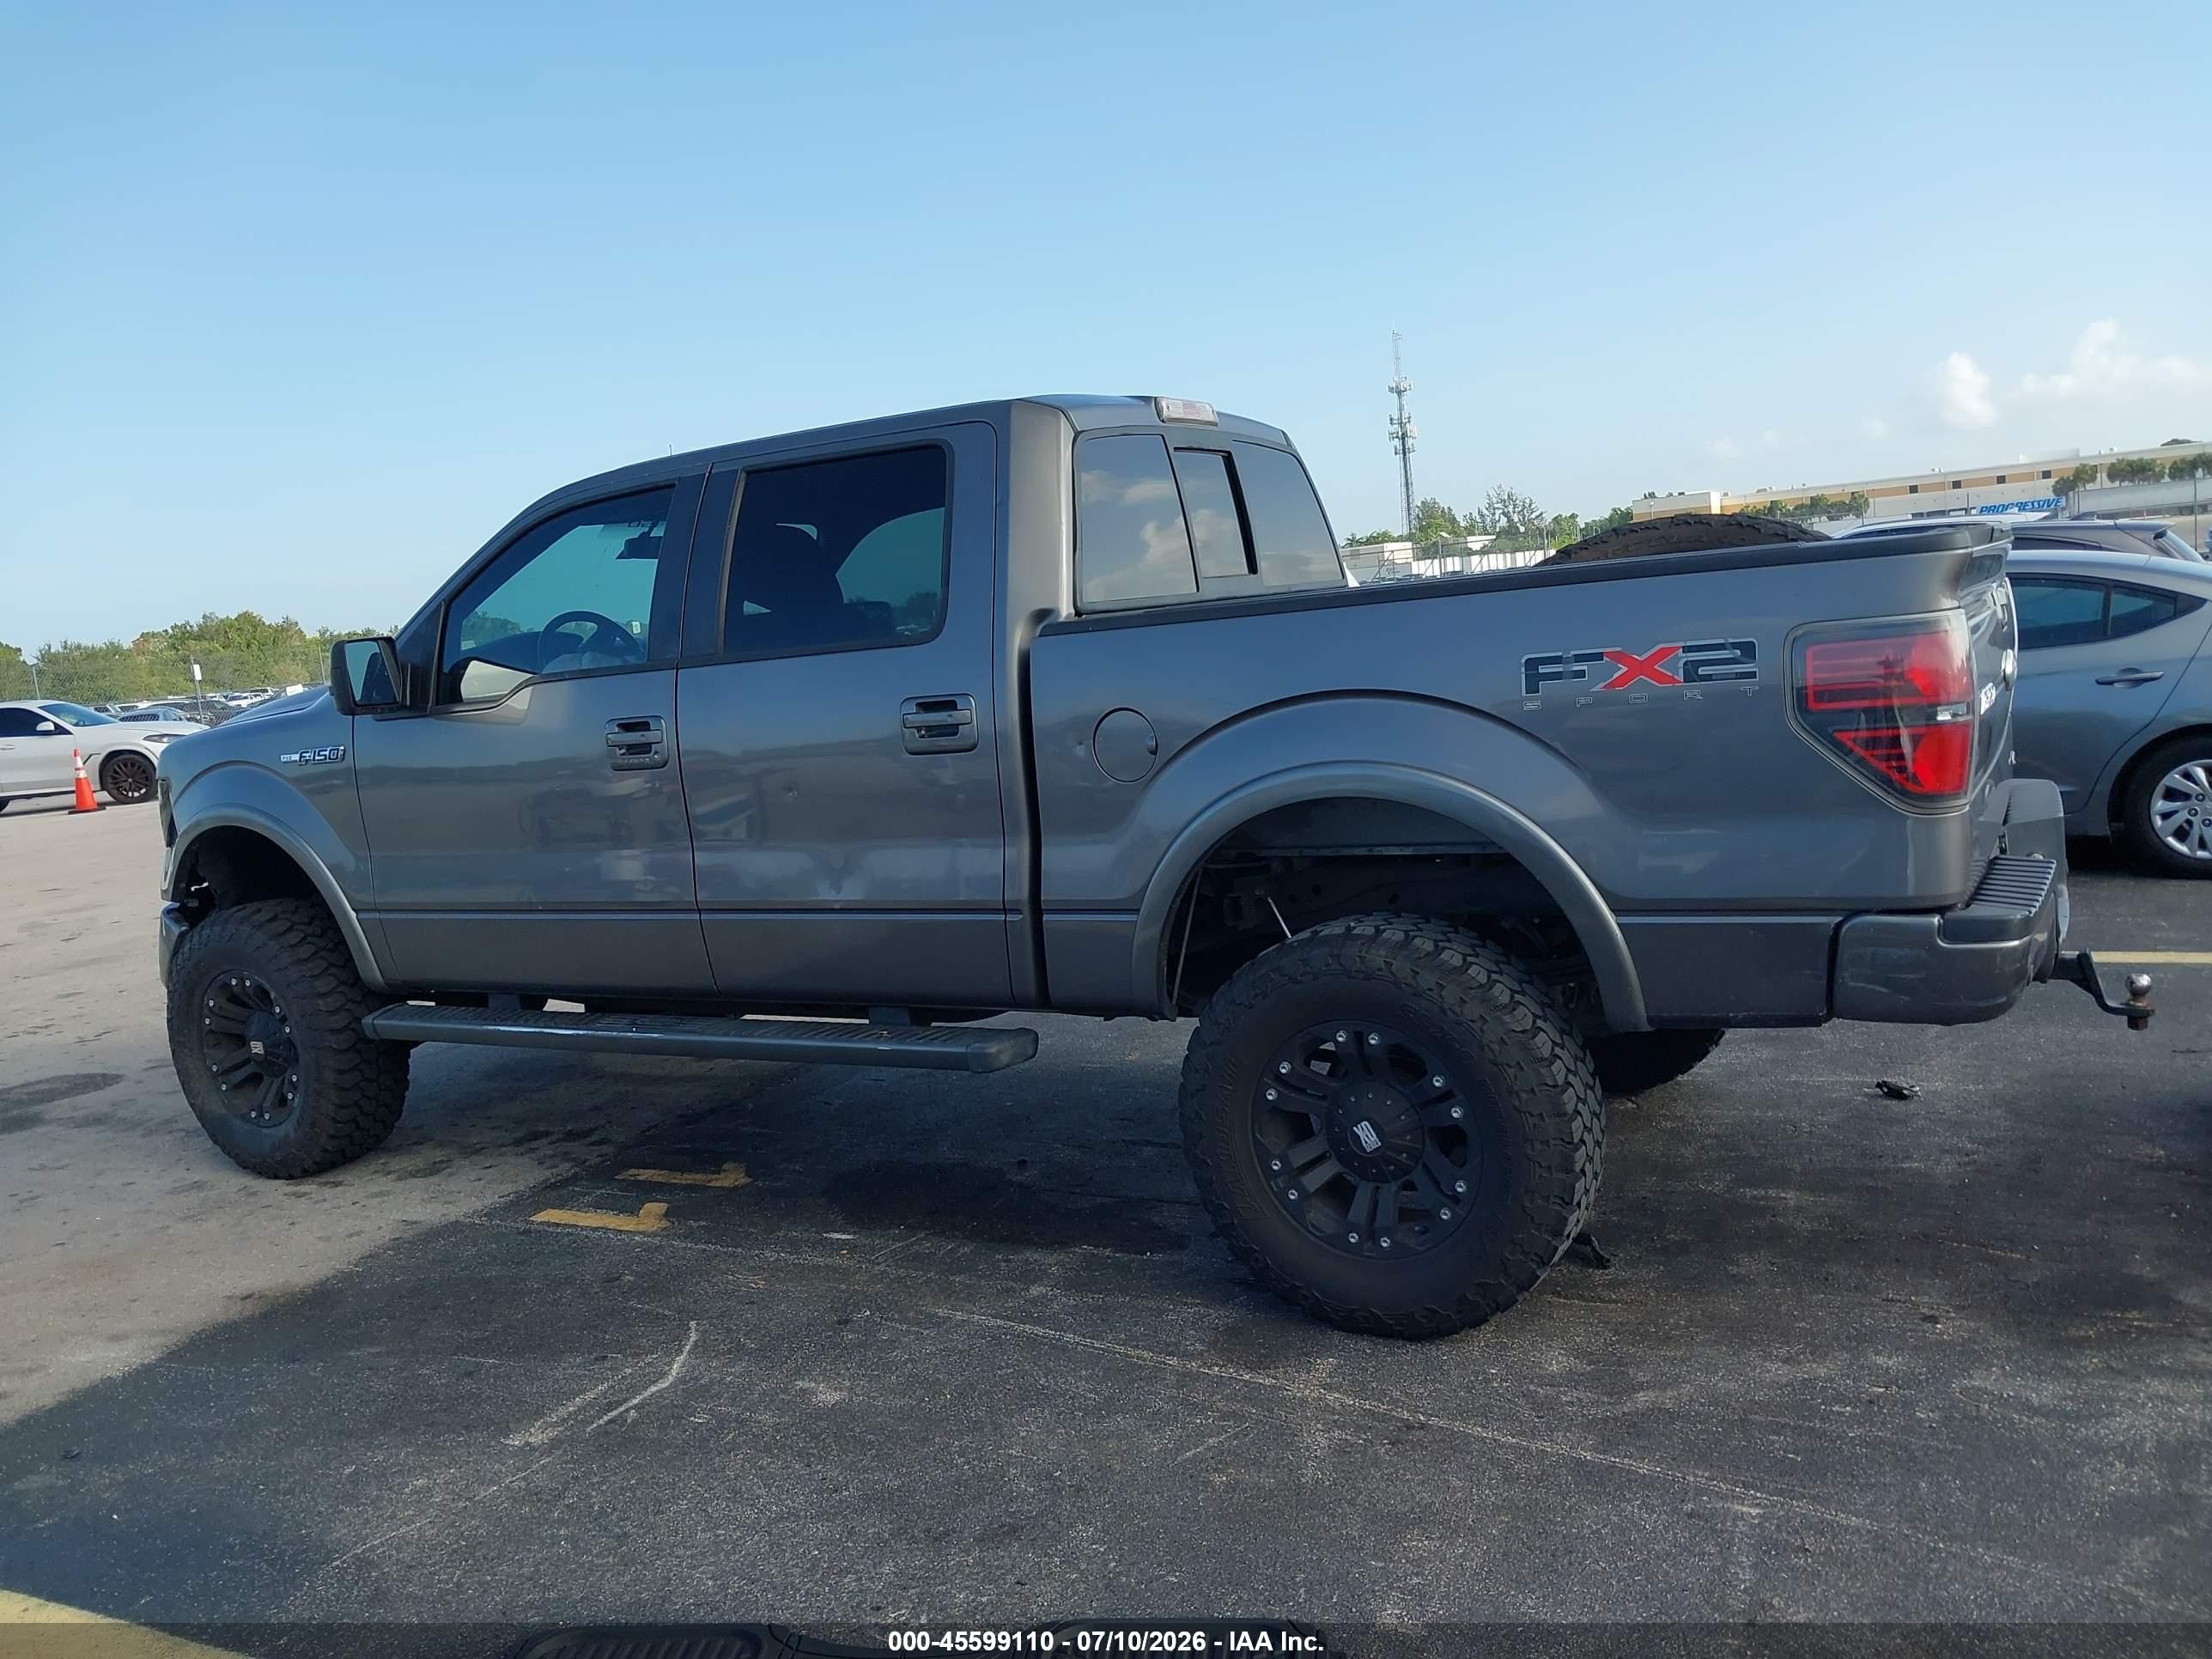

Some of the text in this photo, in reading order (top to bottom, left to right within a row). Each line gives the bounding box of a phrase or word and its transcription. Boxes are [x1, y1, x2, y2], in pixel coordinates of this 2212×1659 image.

[1521, 637, 1759, 696] FX2
[1522, 685, 1759, 711] SPORT
[298, 746, 342, 764] F-150
